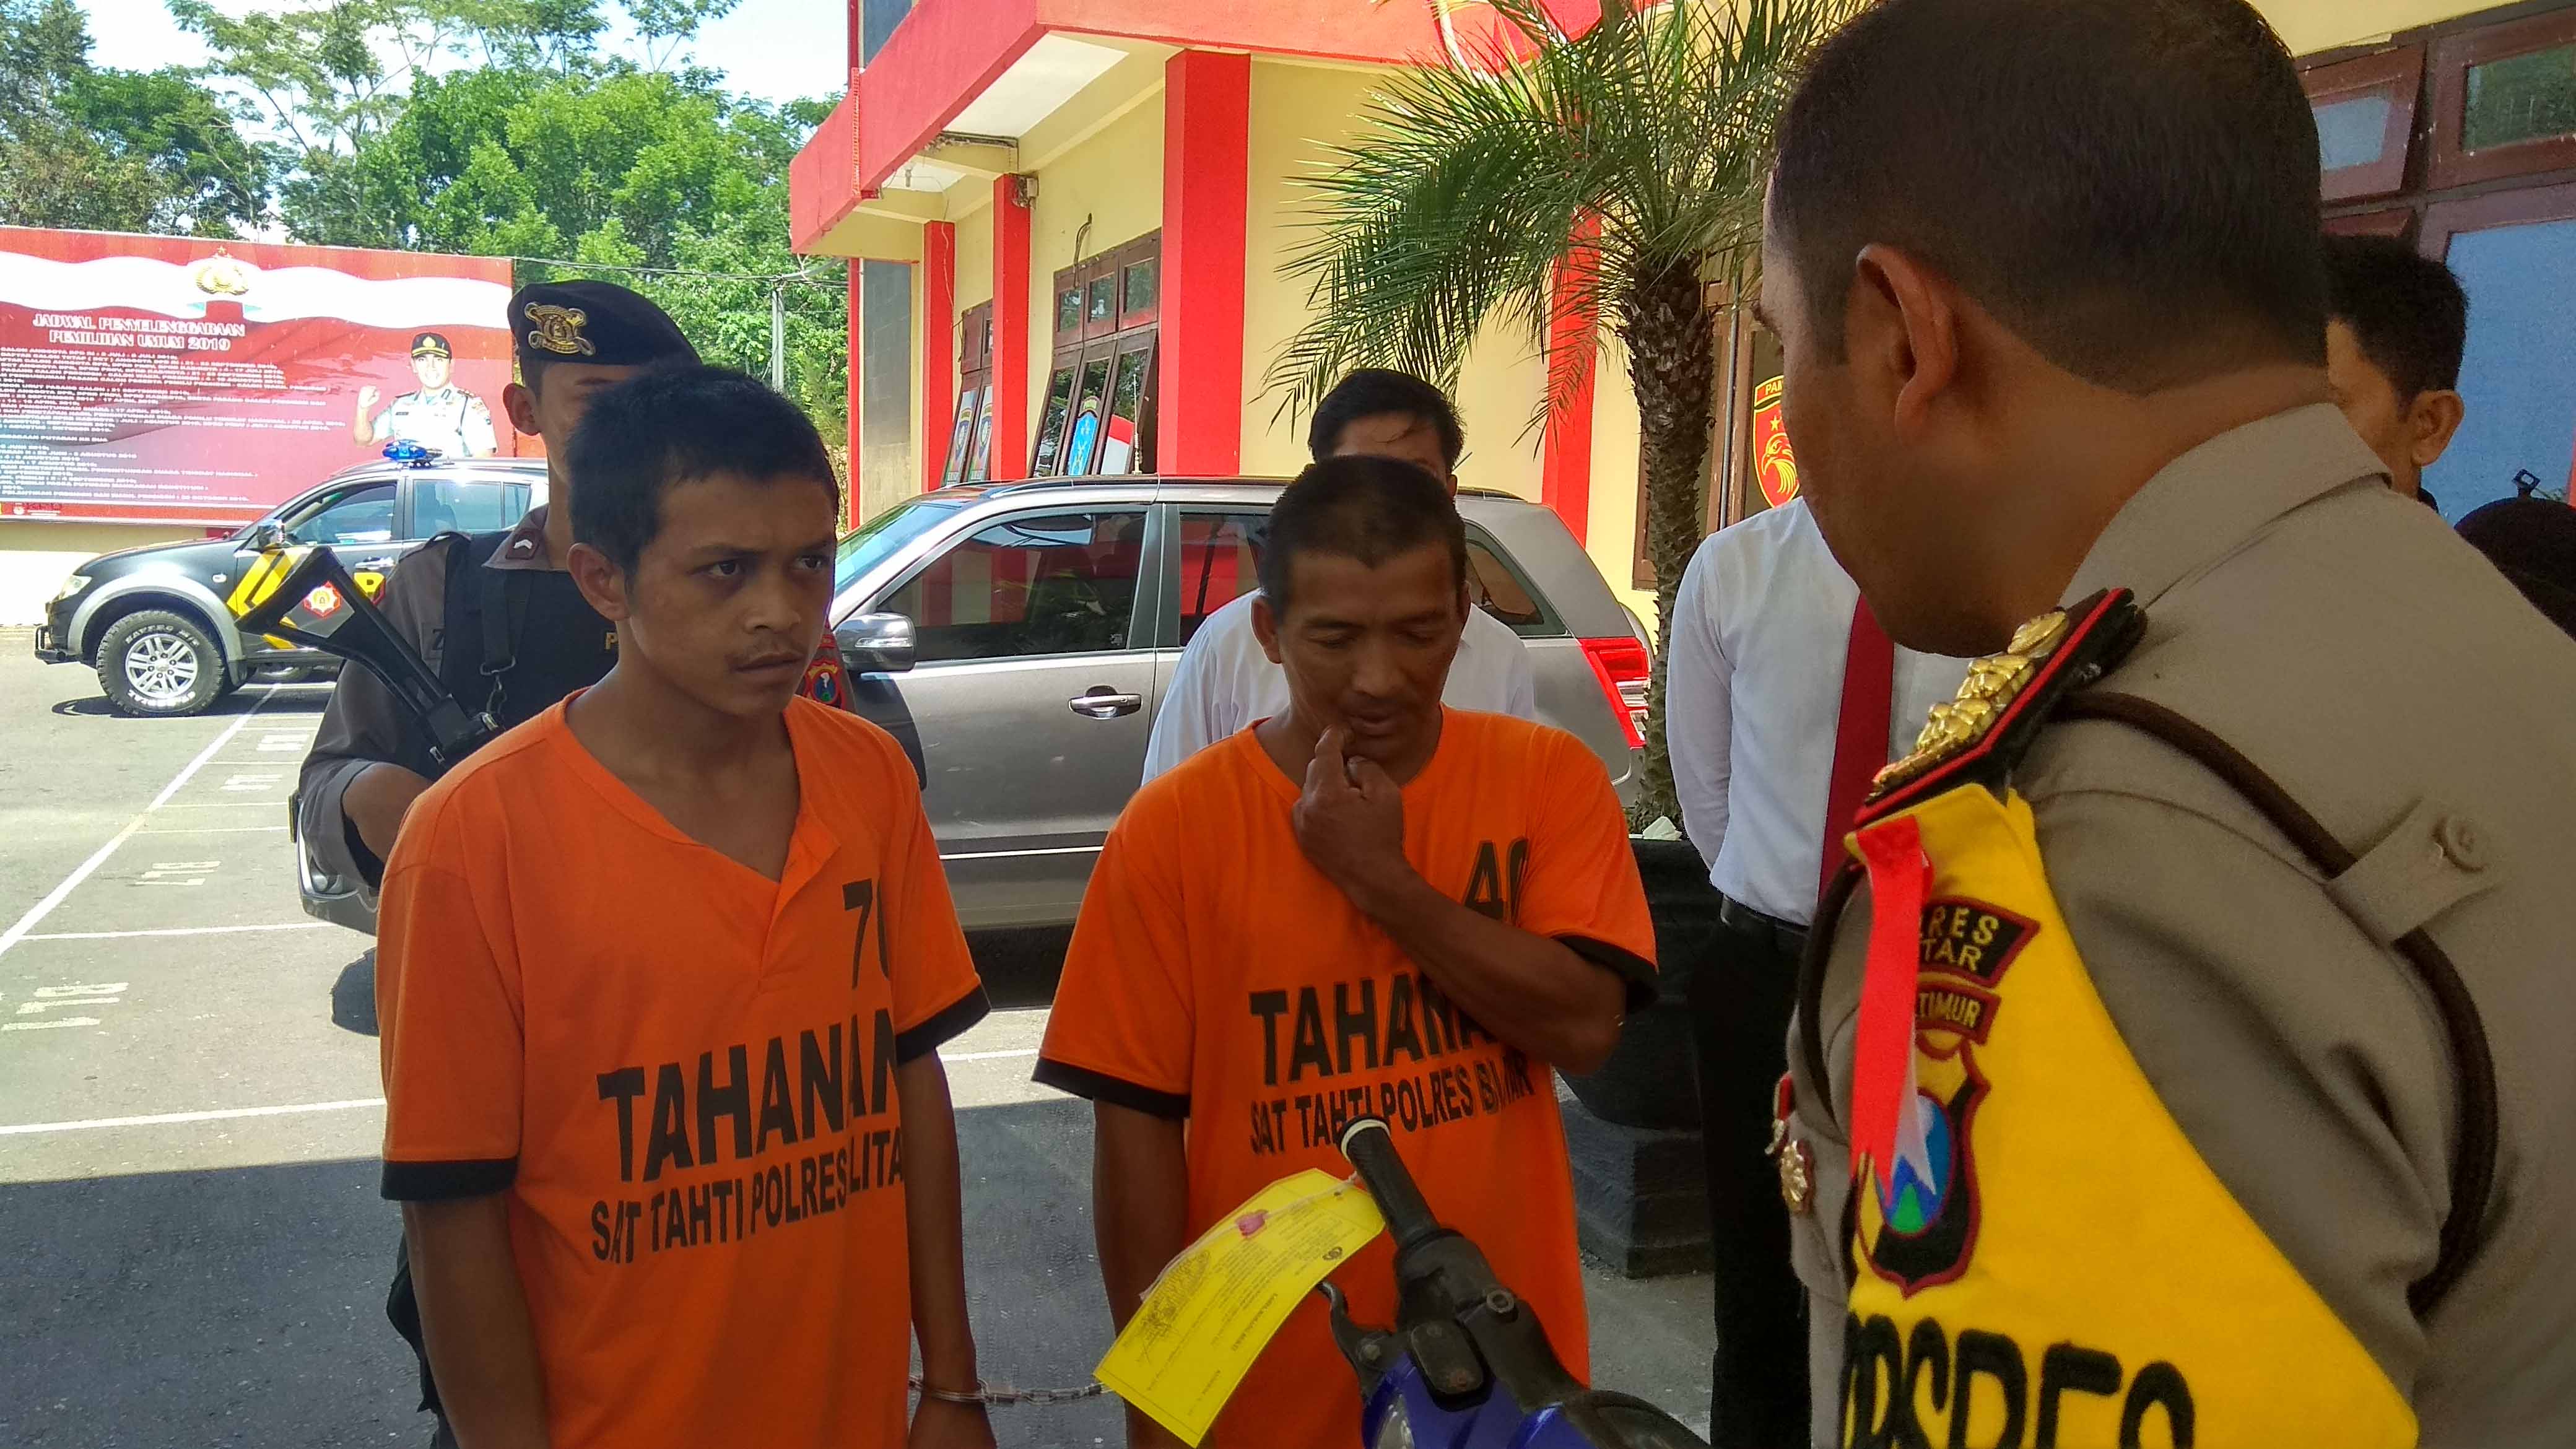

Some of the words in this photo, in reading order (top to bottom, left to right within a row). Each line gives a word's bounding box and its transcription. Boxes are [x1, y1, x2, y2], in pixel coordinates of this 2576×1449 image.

[33, 313, 96, 328] JADWAL
[99, 318, 245, 336] PENYELENGGARAAN
[50, 330, 134, 346] PEMILIHAN
[137, 335, 185, 349] UMUM
[188, 336, 230, 351] 2019
[650, 1178, 742, 1253] TAHTI
[751, 1149, 848, 1234] POLRES
